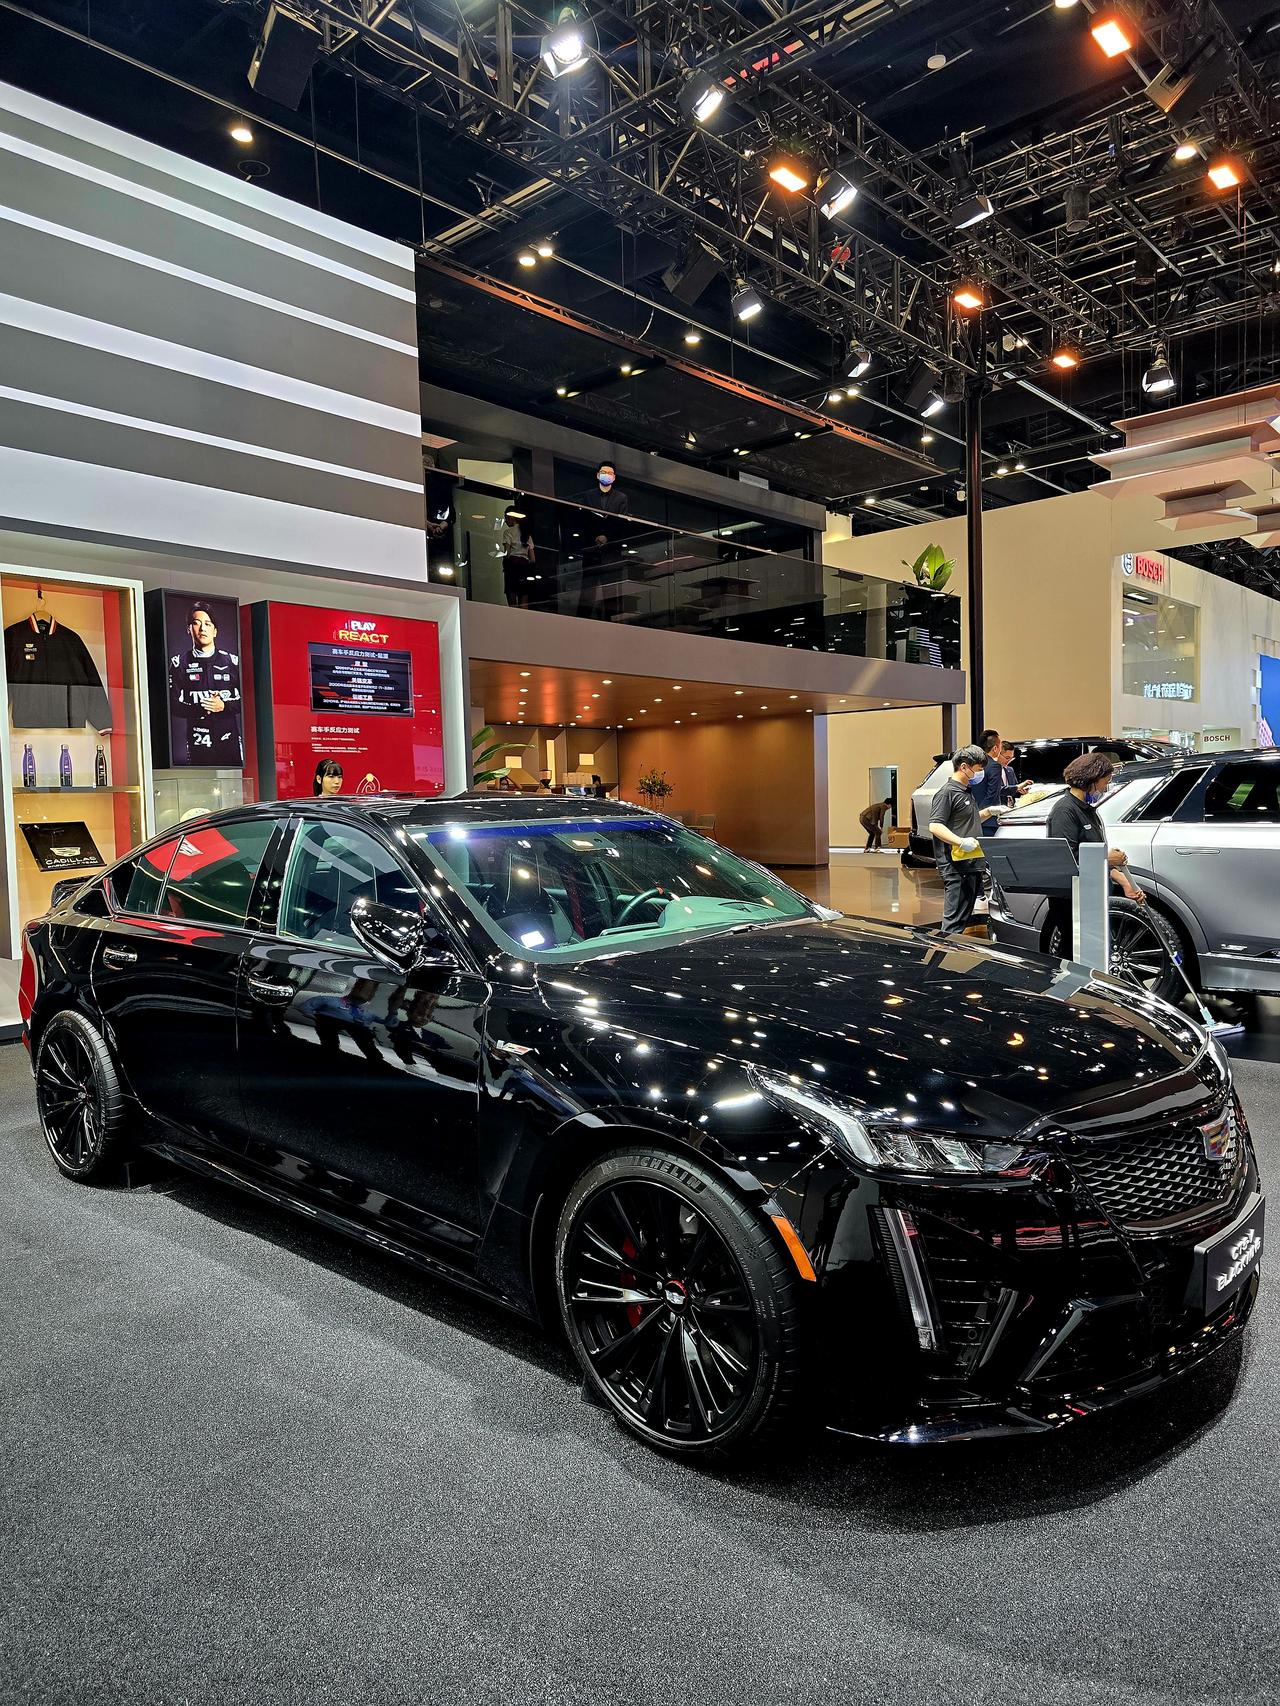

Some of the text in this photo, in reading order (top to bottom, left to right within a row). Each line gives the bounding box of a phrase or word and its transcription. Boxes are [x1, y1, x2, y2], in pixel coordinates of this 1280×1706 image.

[1136, 556, 1163, 582] BOSCH
[350, 620, 376, 631] PLAY
[338, 629, 389, 644] REACT
[192, 732, 212, 747] 24
[1203, 734, 1231, 743] BOSCH
[45, 856, 97, 866] CADILLAC
[617, 1155, 702, 1190] MICHELIN
